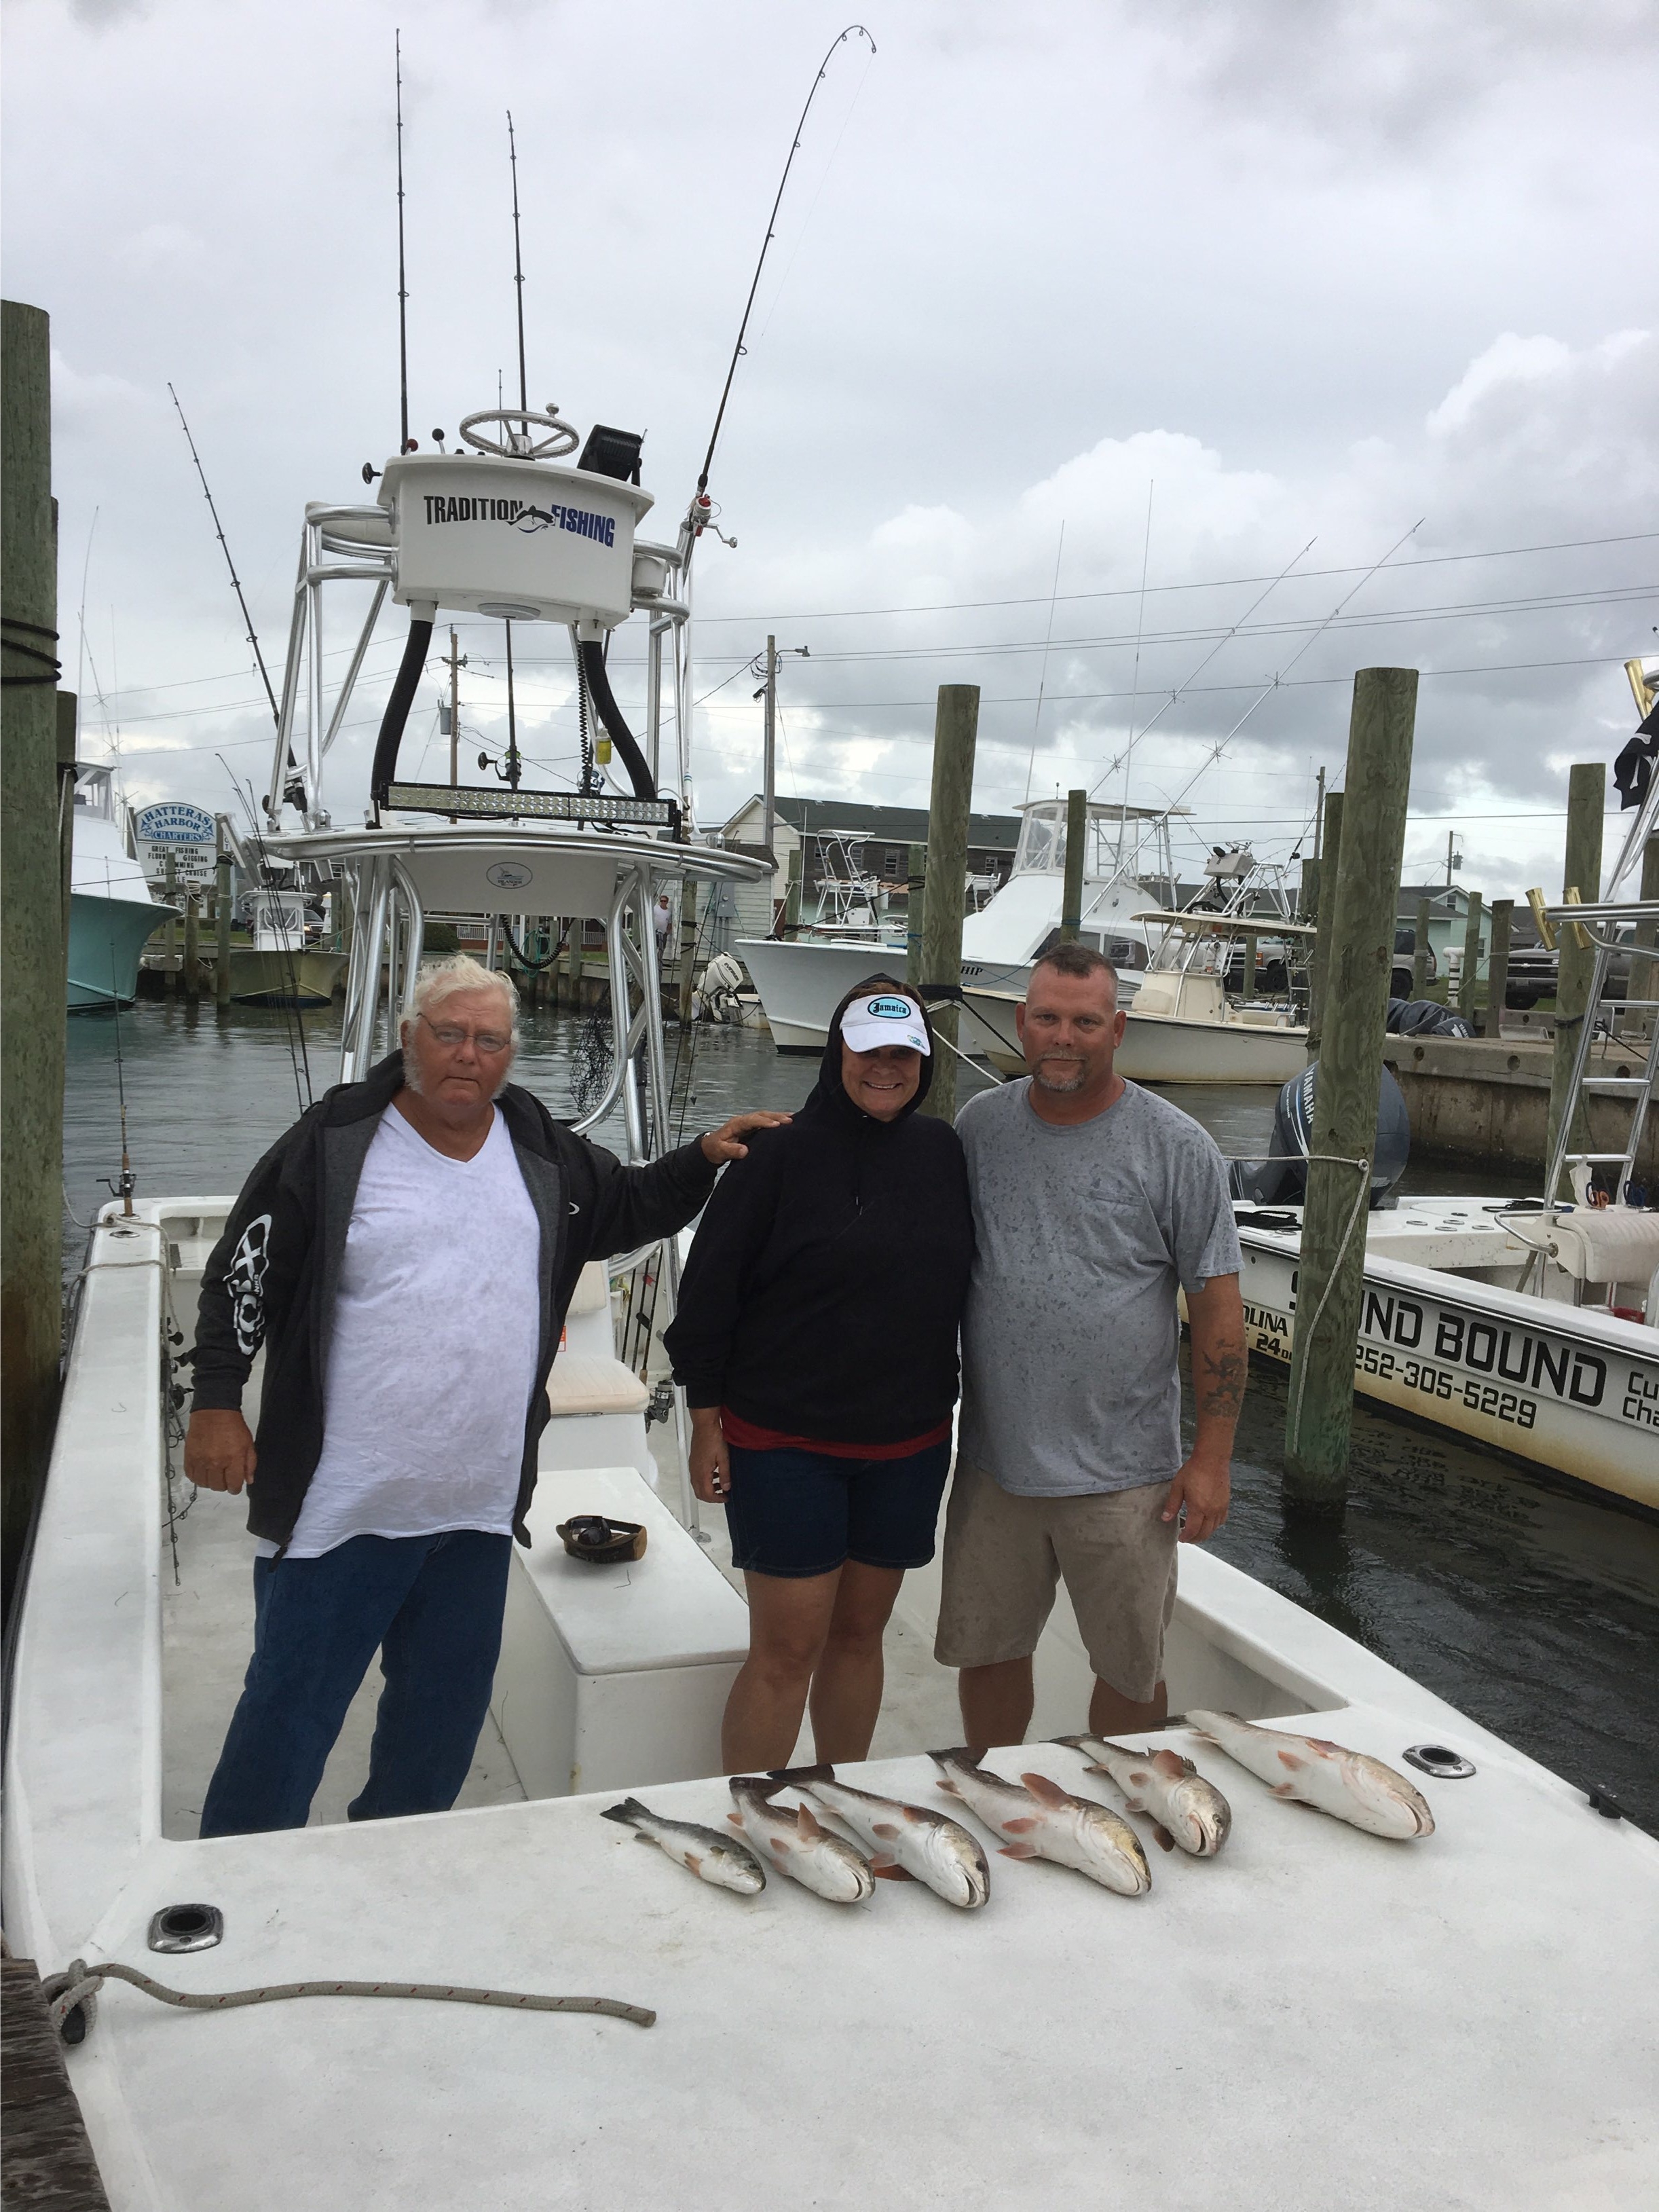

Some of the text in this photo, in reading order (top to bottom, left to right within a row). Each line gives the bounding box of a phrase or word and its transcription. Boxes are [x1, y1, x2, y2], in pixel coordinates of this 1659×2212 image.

[424, 496, 615, 548] TRADITION FISHING
[144, 806, 211, 826] HATTERAS
[155, 817, 201, 832] HARBOR
[154, 830, 201, 842] CHARTERS
[175, 847, 198, 855] FISHING
[872, 1002, 907, 1014] Jamaica
[1459, 1023, 1470, 1037] YAMA
[1303, 1067, 1315, 1124] YAMAHA
[1434, 1312, 1607, 1407] BOUND
[1356, 1344, 1537, 1429] 252-305-5229
